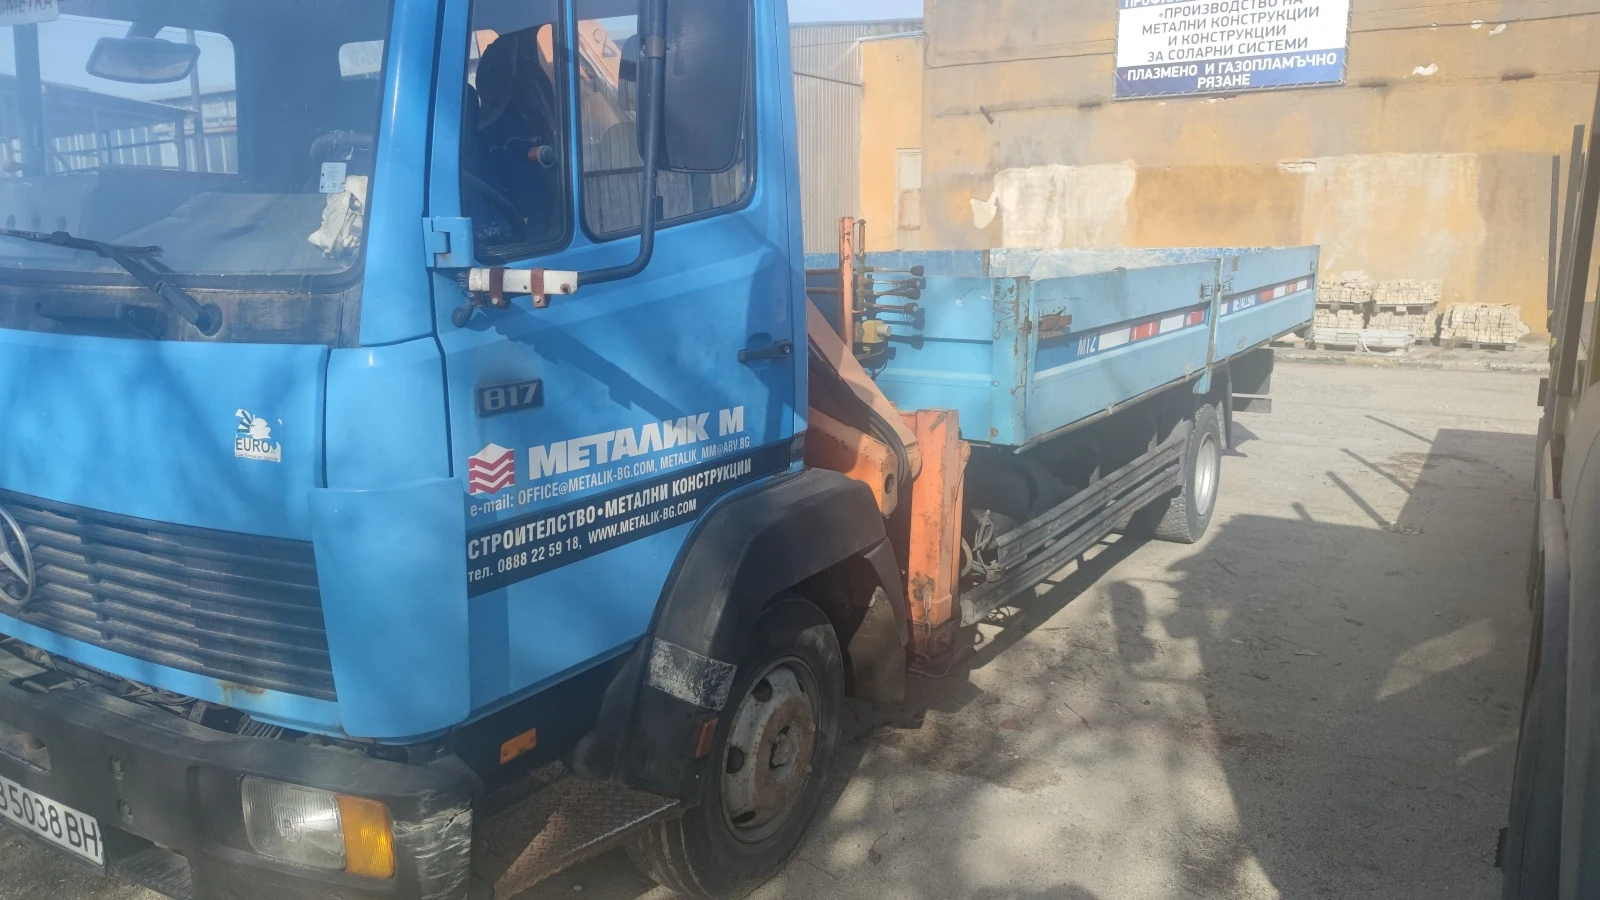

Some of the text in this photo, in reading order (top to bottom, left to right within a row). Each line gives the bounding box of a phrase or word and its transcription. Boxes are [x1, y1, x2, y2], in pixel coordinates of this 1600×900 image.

[1142, 6, 1320, 35] МЕТАЛНИ КОНСТРУКЦИИ
[1147, 37, 1308, 63] ЗА СОЛАРНИ СИСТЕМИ
[1168, 25, 1287, 47] И КОНСТРУКЦИИ
[1127, 52, 1337, 82] ПЛАЗМЕНО И ГАЗОПЛАМЪЧНО
[1197, 73, 1251, 89] РЯЗАНЕ
[484, 382, 538, 410] 817
[235, 437, 270, 453] EURO
[528, 405, 744, 480] МЕТАЛИК М
[470, 436, 751, 517] e-mail: OFFICE@METALIK-BG.COM, METALIK_MM@ABV.BG
[672, 457, 752, 497] КОНСТРУКЦИИ
[467, 498, 697, 583] тел. 0888 22 59 18, WWW.METALIK-BG.COM
